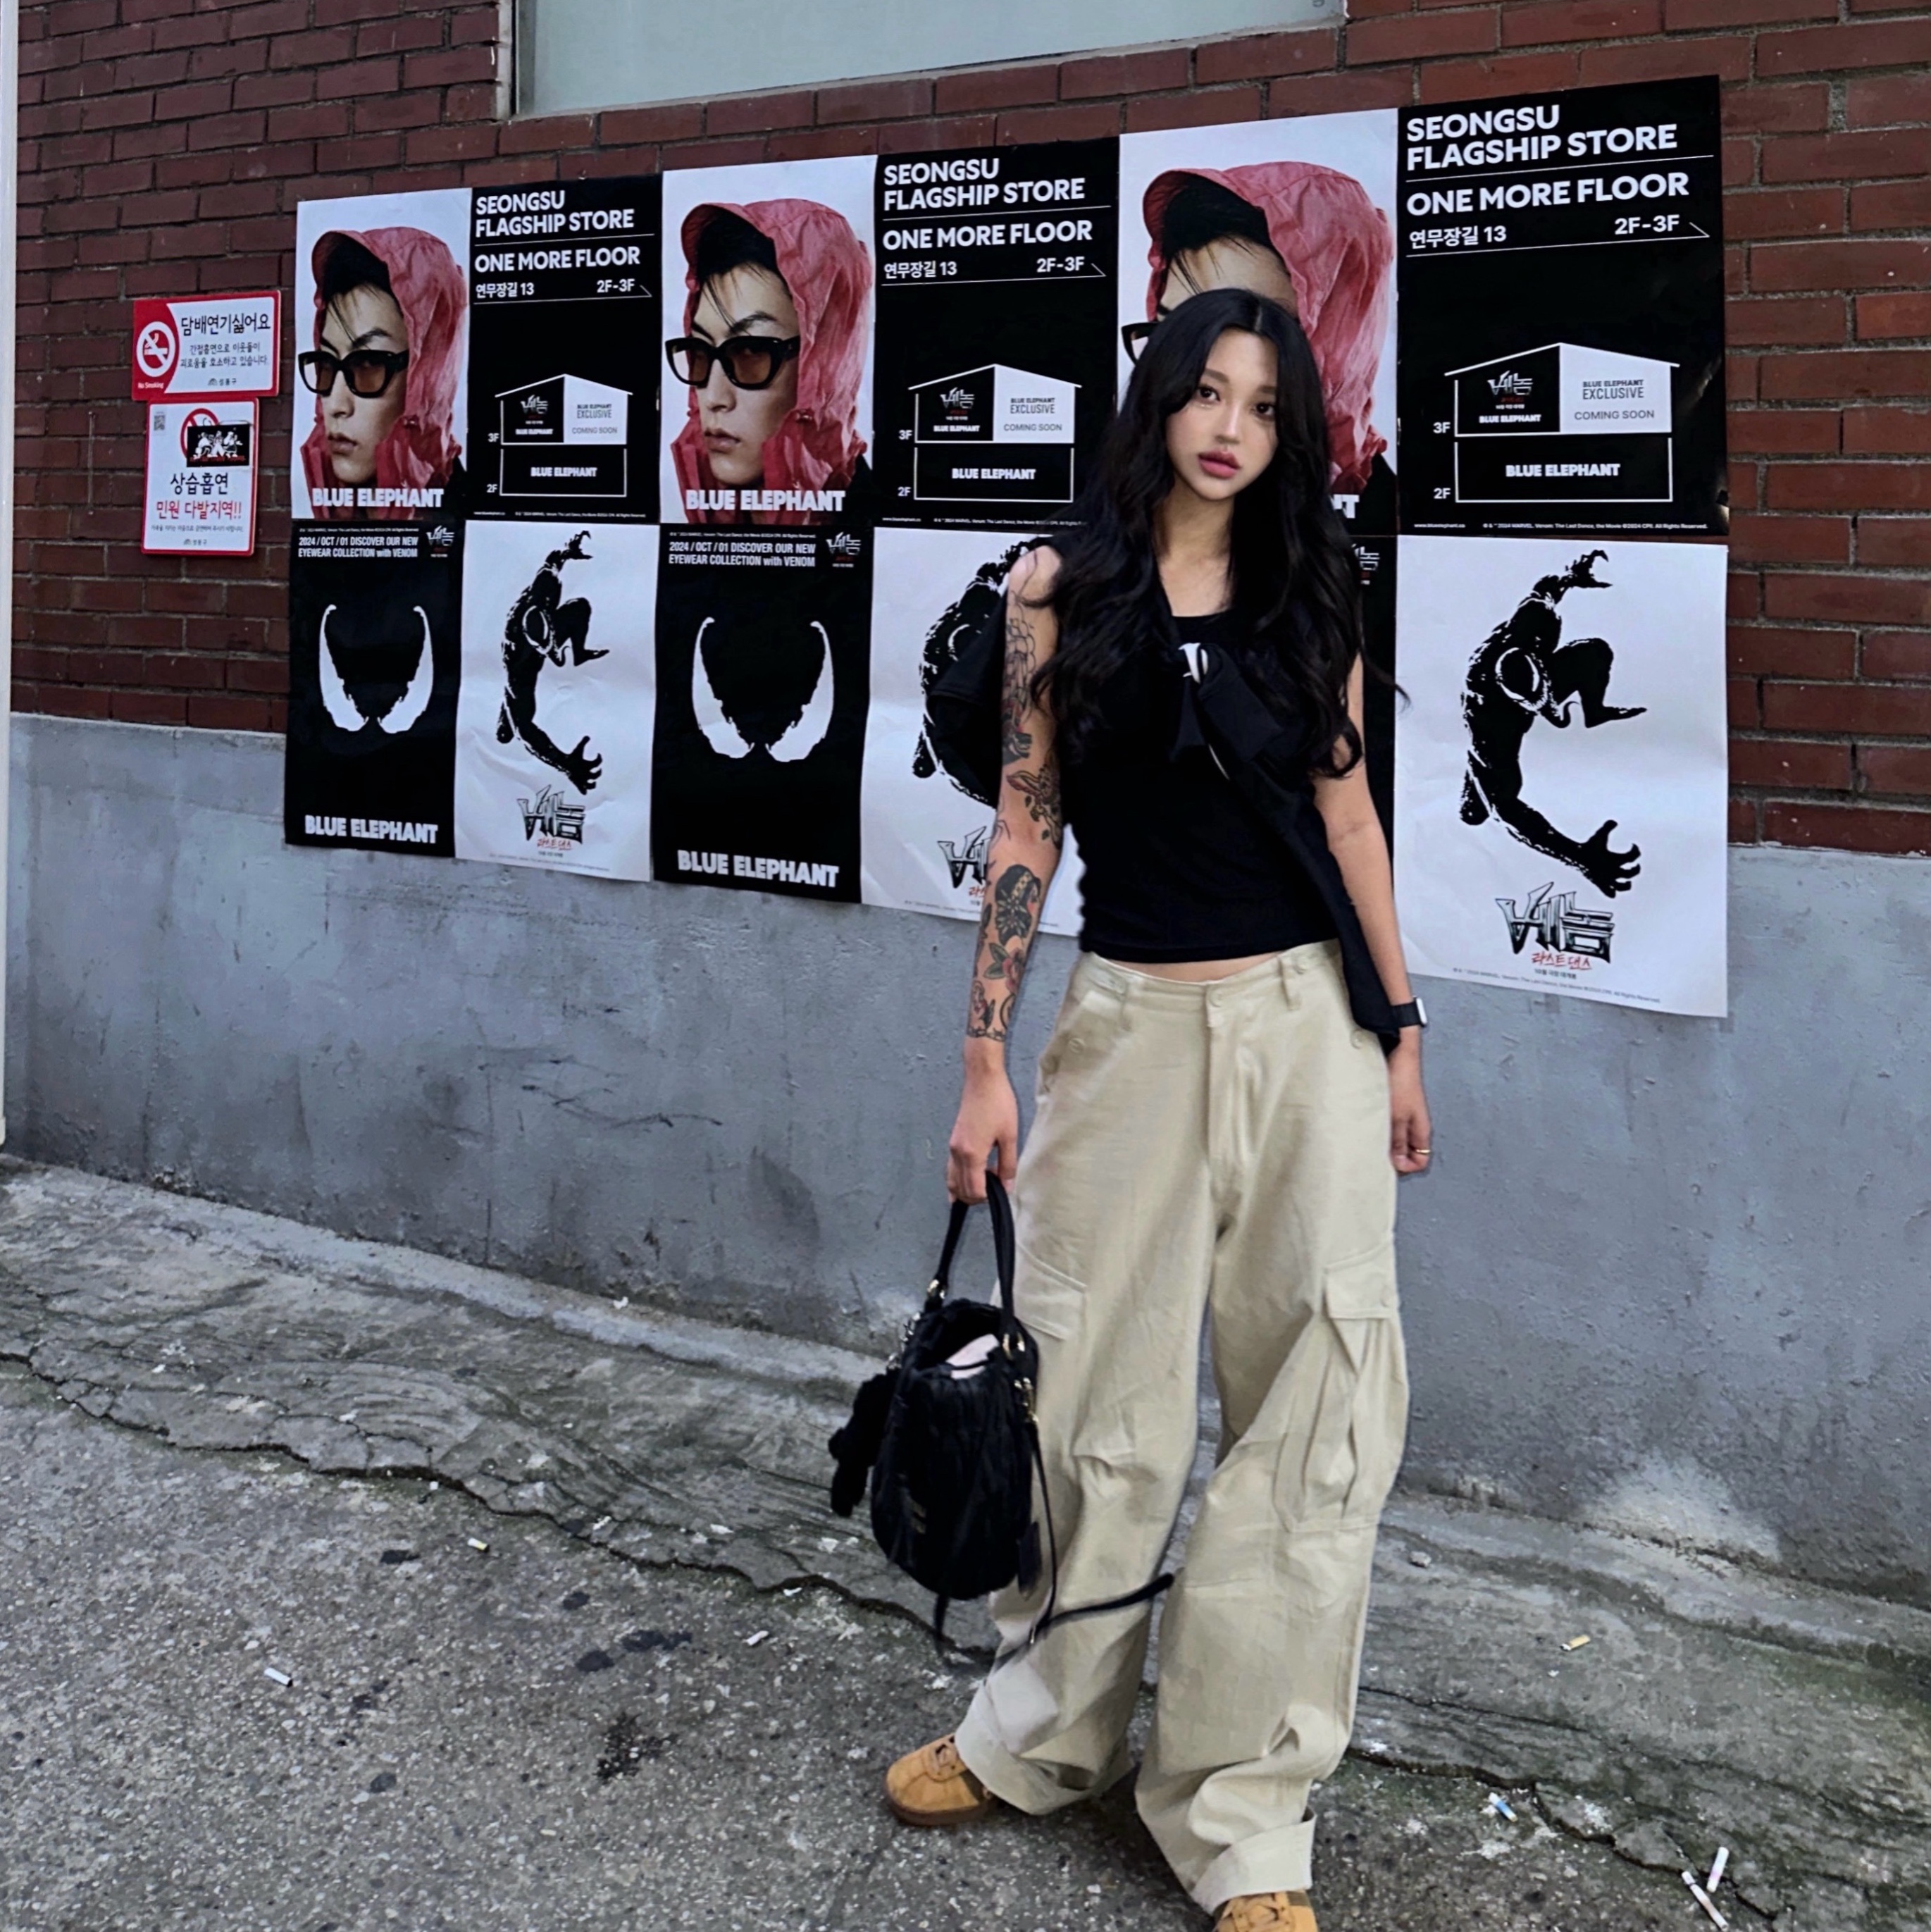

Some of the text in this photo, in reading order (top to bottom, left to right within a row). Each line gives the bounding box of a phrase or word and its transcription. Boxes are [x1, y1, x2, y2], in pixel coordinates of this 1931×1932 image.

[1407, 104, 1560, 142] SEONGSU
[1408, 123, 1678, 171] FLAGSHIP STORE
[883, 158, 999, 186] SEONGSU
[476, 190, 565, 215] SEONGSU
[883, 178, 1085, 211] FLAGSHIP STORE
[1406, 172, 1689, 216] ONE MORE FLOOR
[476, 209, 634, 237] FLAGSHIP STORE
[1615, 214, 1679, 235] 2F-3F
[882, 220, 1093, 250] ONE MORE FLOOR
[1409, 225, 1506, 249] 연무장길 13
[474, 246, 640, 273] ONE MORE FLOOR
[1037, 256, 1085, 273] 2F-3F
[884, 261, 957, 279] 연무장길 13
[476, 282, 534, 299] 연무장길 13
[597, 278, 635, 292] 2F-3F
[181, 312, 271, 336] 담배연기싫어요
[210, 357, 237, 366] 호소하고
[1582, 388, 1644, 400] EXCLUSIVE
[577, 409, 612, 419] EXCLUSIVE
[1010, 404, 1055, 414] EXCLUSIVE
[1575, 410, 1655, 421] COMING SOON
[1501, 414, 1541, 423] ELEPHANT
[899, 430, 912, 440] 3F
[1433, 422, 1451, 434] 3F
[488, 433, 499, 442] 3F
[530, 467, 597, 477] BLUE ELEPHANT
[952, 468, 1036, 479] BLUE ELEPHANT
[1505, 464, 1620, 478] BLUE ELEPHANT
[170, 472, 228, 495] 상습흡연
[486, 484, 498, 493] 2F
[898, 487, 911, 496] 2F
[312, 488, 444, 507] BLUE ELEPHANT
[686, 490, 845, 512] BLUE ELEPHANT
[1434, 488, 1451, 499] 2F
[156, 500, 242, 520] 민원 다발지역!!
[299, 537, 316, 545] 2024
[321, 537, 335, 545] OCT
[341, 537, 349, 545] 01
[350, 537, 385, 546] DISCOVER
[386, 537, 400, 546] OUR
[402, 537, 418, 545] NEW
[669, 542, 689, 552] 2024
[695, 542, 712, 552] OCT
[719, 543, 728, 552] 01
[731, 543, 773, 552] DISCOVER
[775, 543, 793, 553] OUR
[795, 544, 816, 554] NEW
[298, 548, 418, 557] EYEWEAR COLLECTION with VENOM
[669, 555, 815, 566] EYEWEAR COLLECTION with VENOM
[305, 815, 437, 843] BLUE ELEPHANT
[677, 850, 839, 888] BLUE ELEPHANT
